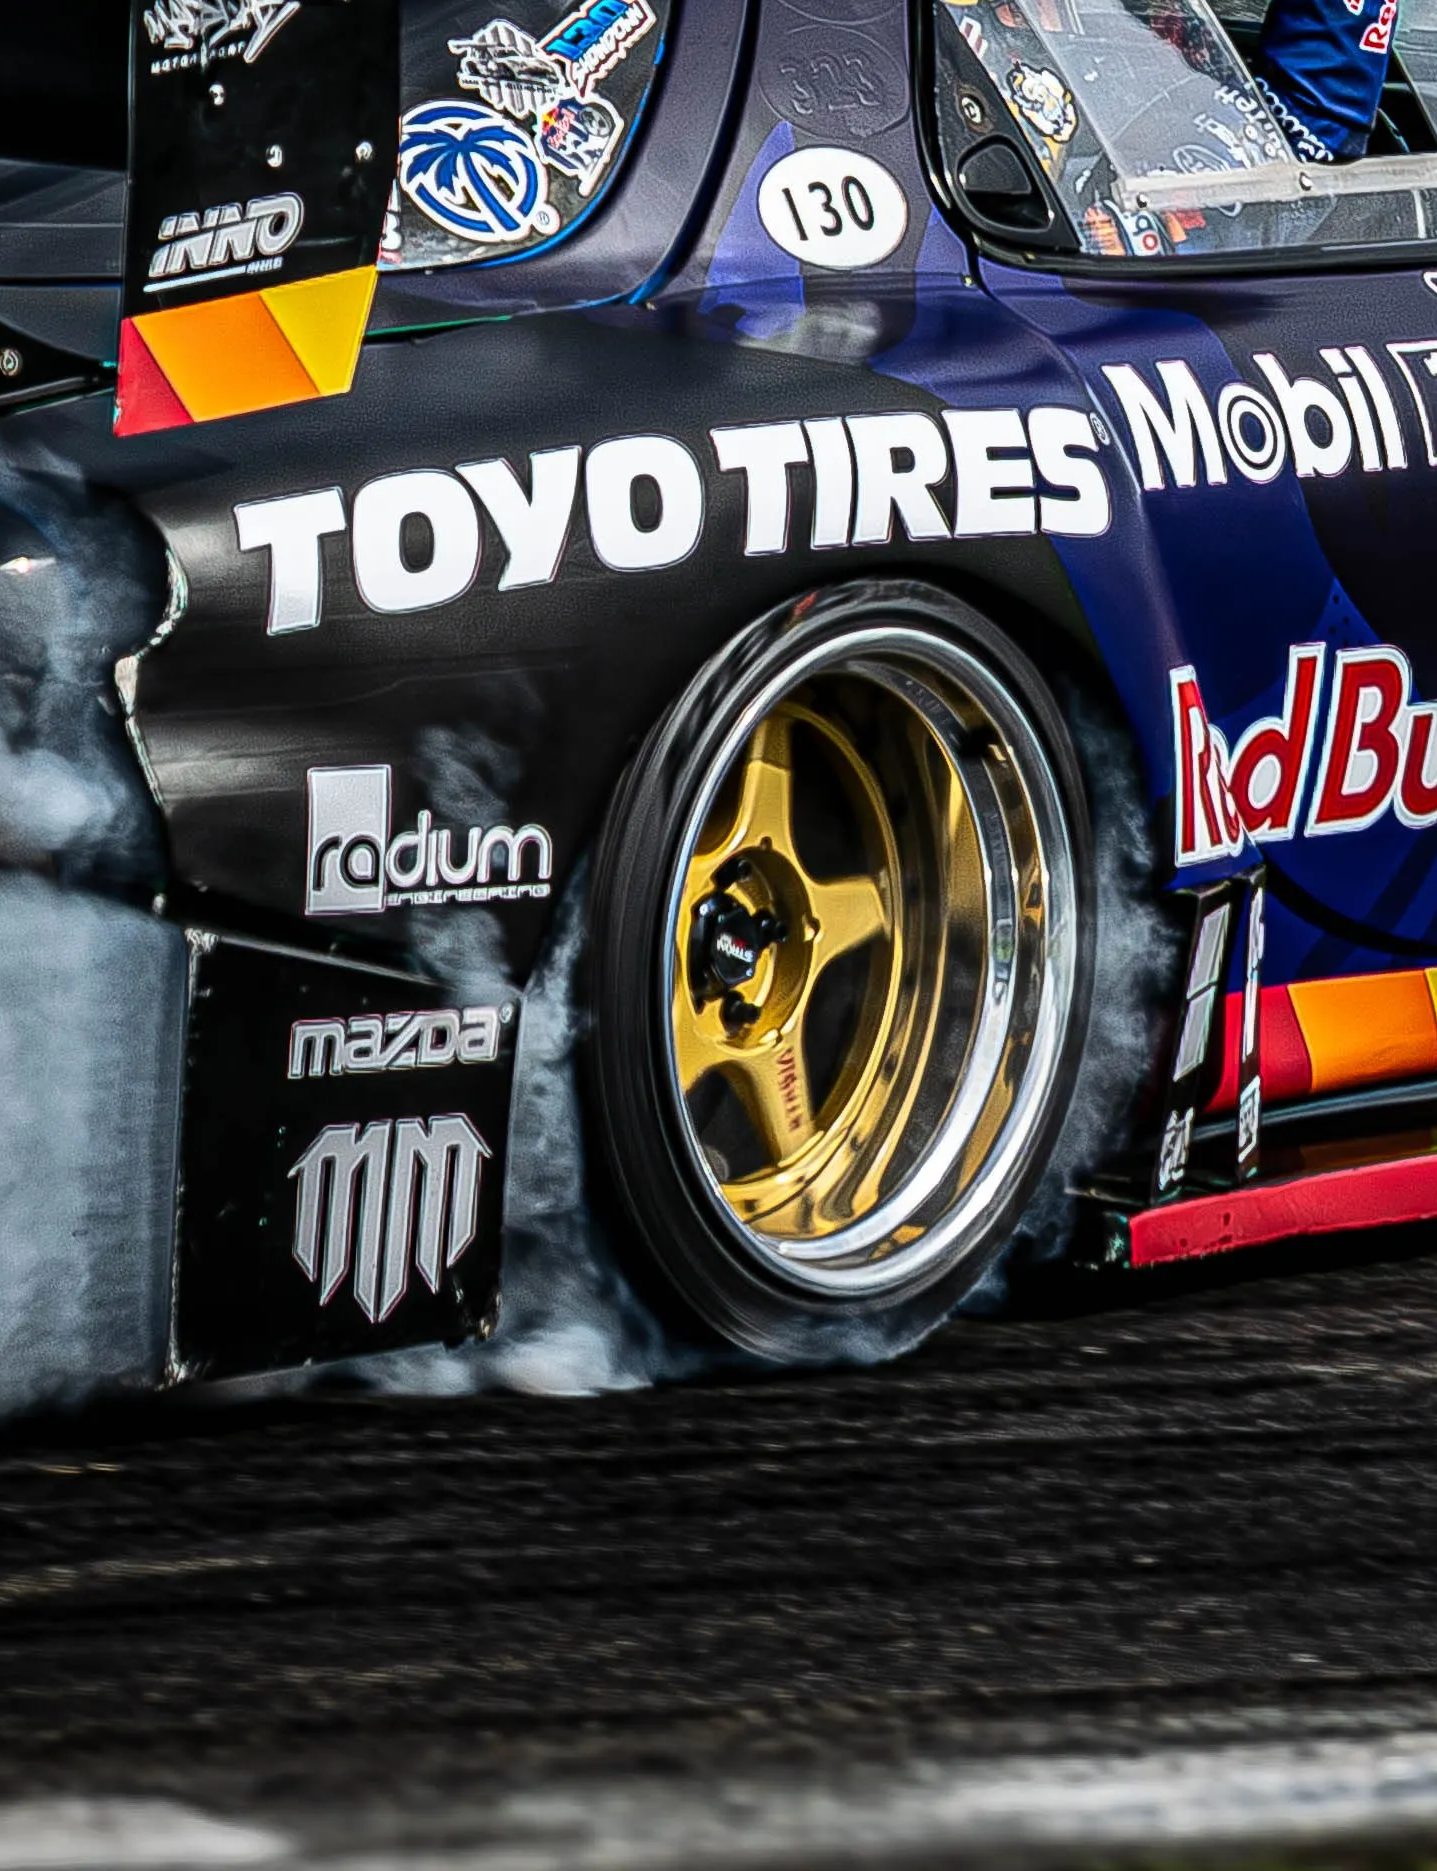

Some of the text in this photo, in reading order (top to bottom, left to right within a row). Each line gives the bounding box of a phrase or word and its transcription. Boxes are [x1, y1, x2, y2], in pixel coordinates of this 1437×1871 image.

[150, 40, 247, 75] MOTORPORT
[782, 174, 876, 243] 130
[1101, 345, 1408, 491] Mobil
[233, 405, 1113, 638] TOYO TIRES
[312, 810, 554, 894] radium
